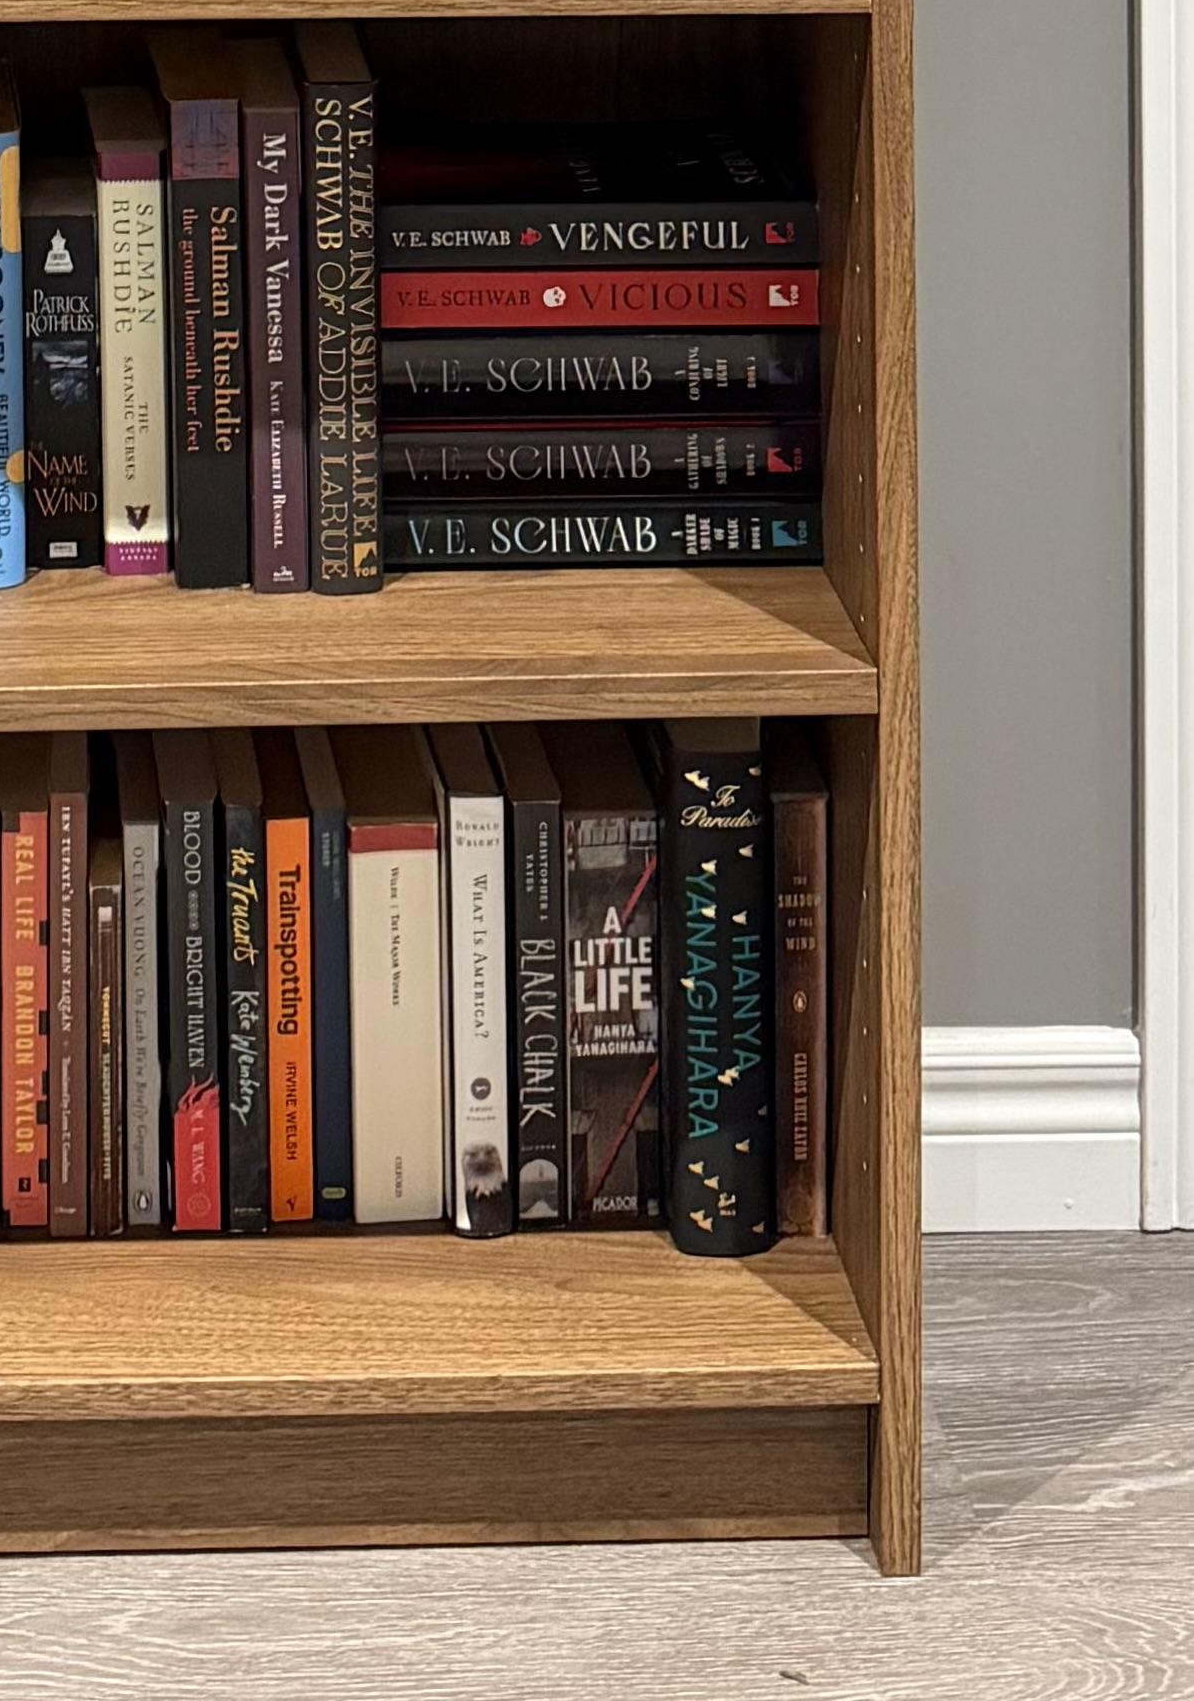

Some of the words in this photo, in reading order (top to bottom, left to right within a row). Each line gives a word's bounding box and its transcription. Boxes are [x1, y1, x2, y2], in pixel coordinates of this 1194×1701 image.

[256, 134, 286, 174] My
[264, 183, 287, 257] Dark
[392, 232, 406, 247] V.
[410, 232, 427, 247] E.
[431, 230, 510, 247] SCHWAB
[548, 221, 749, 252] VENGEFUL
[210, 205, 238, 319] Salman
[33, 290, 89, 314] PATRICK
[265, 260, 289, 364] Vanessa
[579, 283, 747, 310] VICIOUS
[26, 312, 94, 337] ROTHFUSS
[213, 328, 240, 453] Rushdie
[15, 835, 33, 885] REAL
[15, 896, 34, 941] LIFE
[602, 906, 622, 933] A
[277, 864, 301, 1036] Trainspotting
[574, 937, 652, 968] LITTLE
[520, 939, 556, 1025] BLACK
[575, 968, 652, 1013] LIFE
[685, 874, 718, 1140] YANAGIHARA
[731, 935, 761, 1073] HANYA
[15, 966, 34, 1066] BRANDON
[286, 1062, 297, 1104] IRVINE
[519, 1034, 558, 1128] CHALK
[15, 1076, 34, 1155] TAYLOR
[286, 1109, 298, 1160] WELSH
